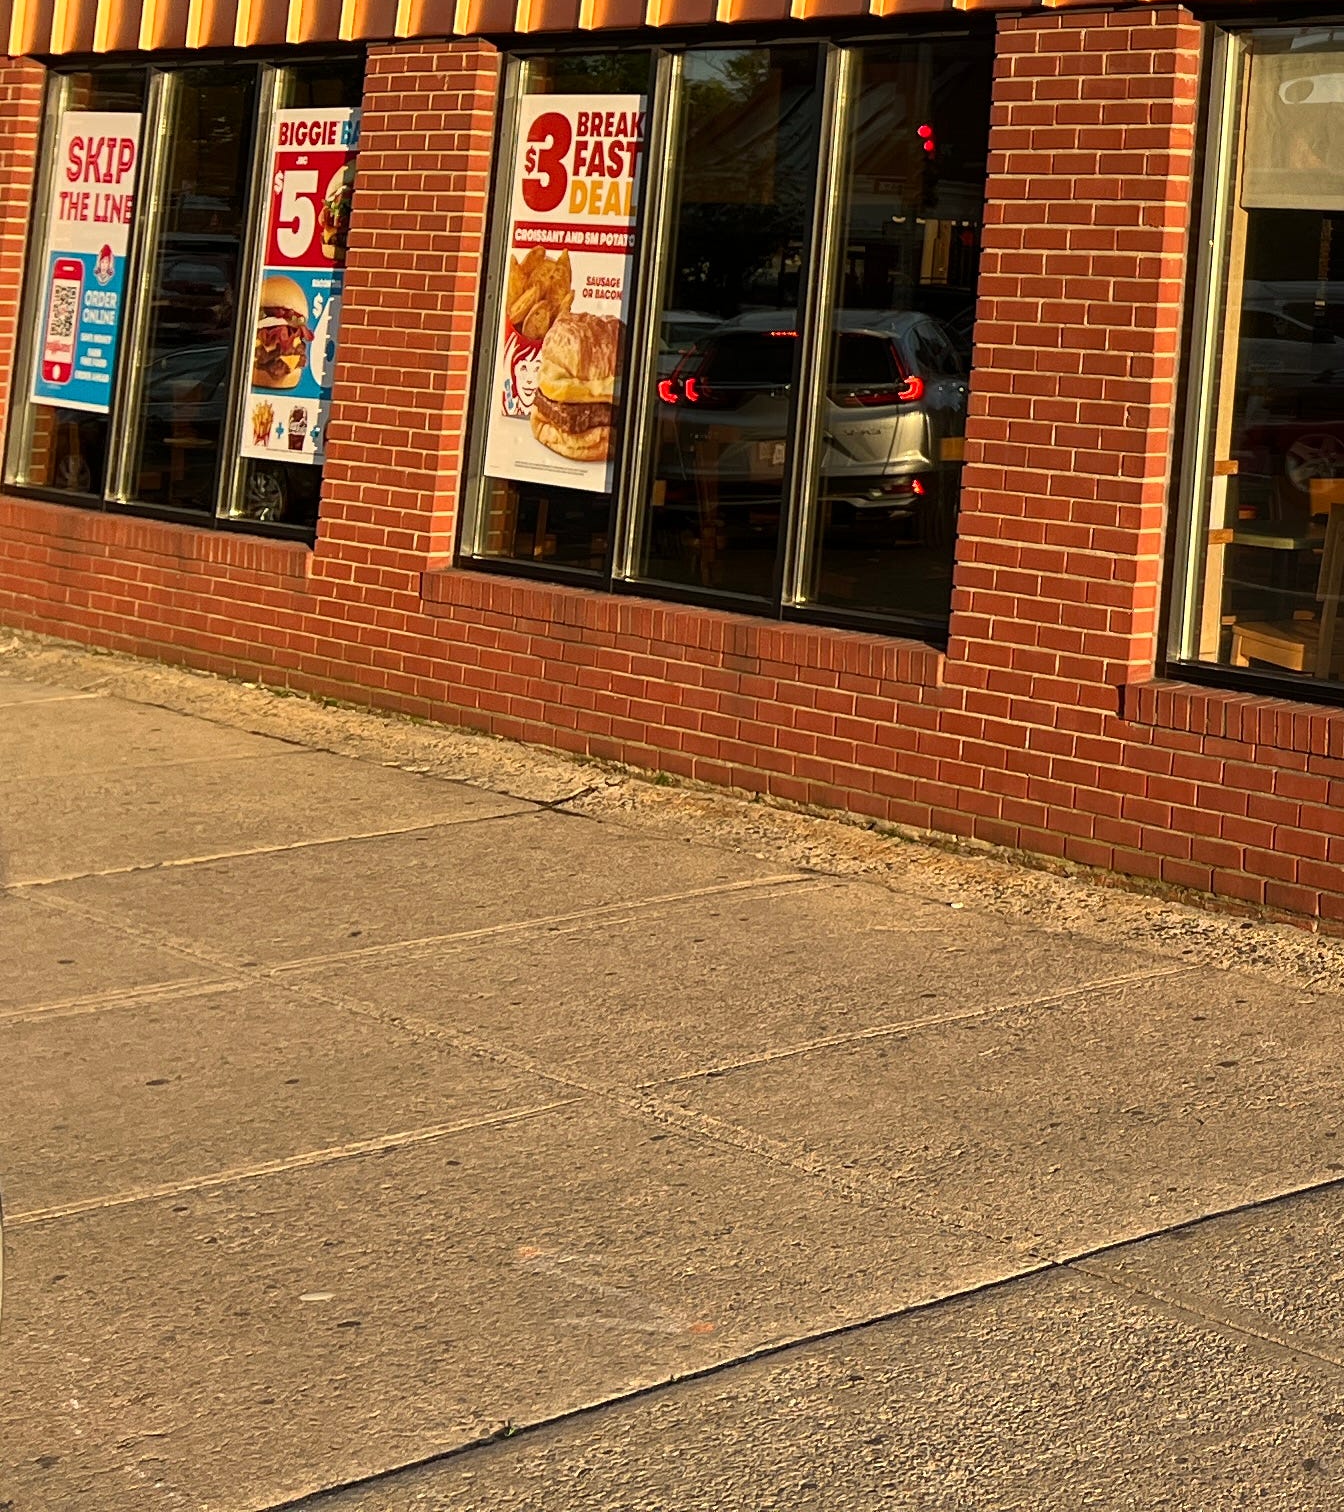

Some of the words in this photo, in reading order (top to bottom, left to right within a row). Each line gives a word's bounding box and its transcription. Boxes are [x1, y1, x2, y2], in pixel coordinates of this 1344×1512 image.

[278, 121, 338, 146] BIGGIE
[576, 111, 647, 138] BREAK
[66, 135, 135, 184] SKIP
[522, 111, 573, 213] $3
[572, 139, 645, 179] FAST
[59, 191, 91, 222] THE
[93, 193, 134, 225] LINE
[568, 179, 637, 217] DEAL
[273, 169, 319, 259] $5
[514, 227, 564, 244] CROISSANT
[564, 230, 585, 245] AND
[584, 231, 600, 247] SM
[582, 288, 593, 299] OR
[595, 289, 623, 301] BACON
[586, 275, 621, 288] SAUSAGE
[84, 289, 118, 310] ORDER
[82, 307, 117, 326] ONLINE
